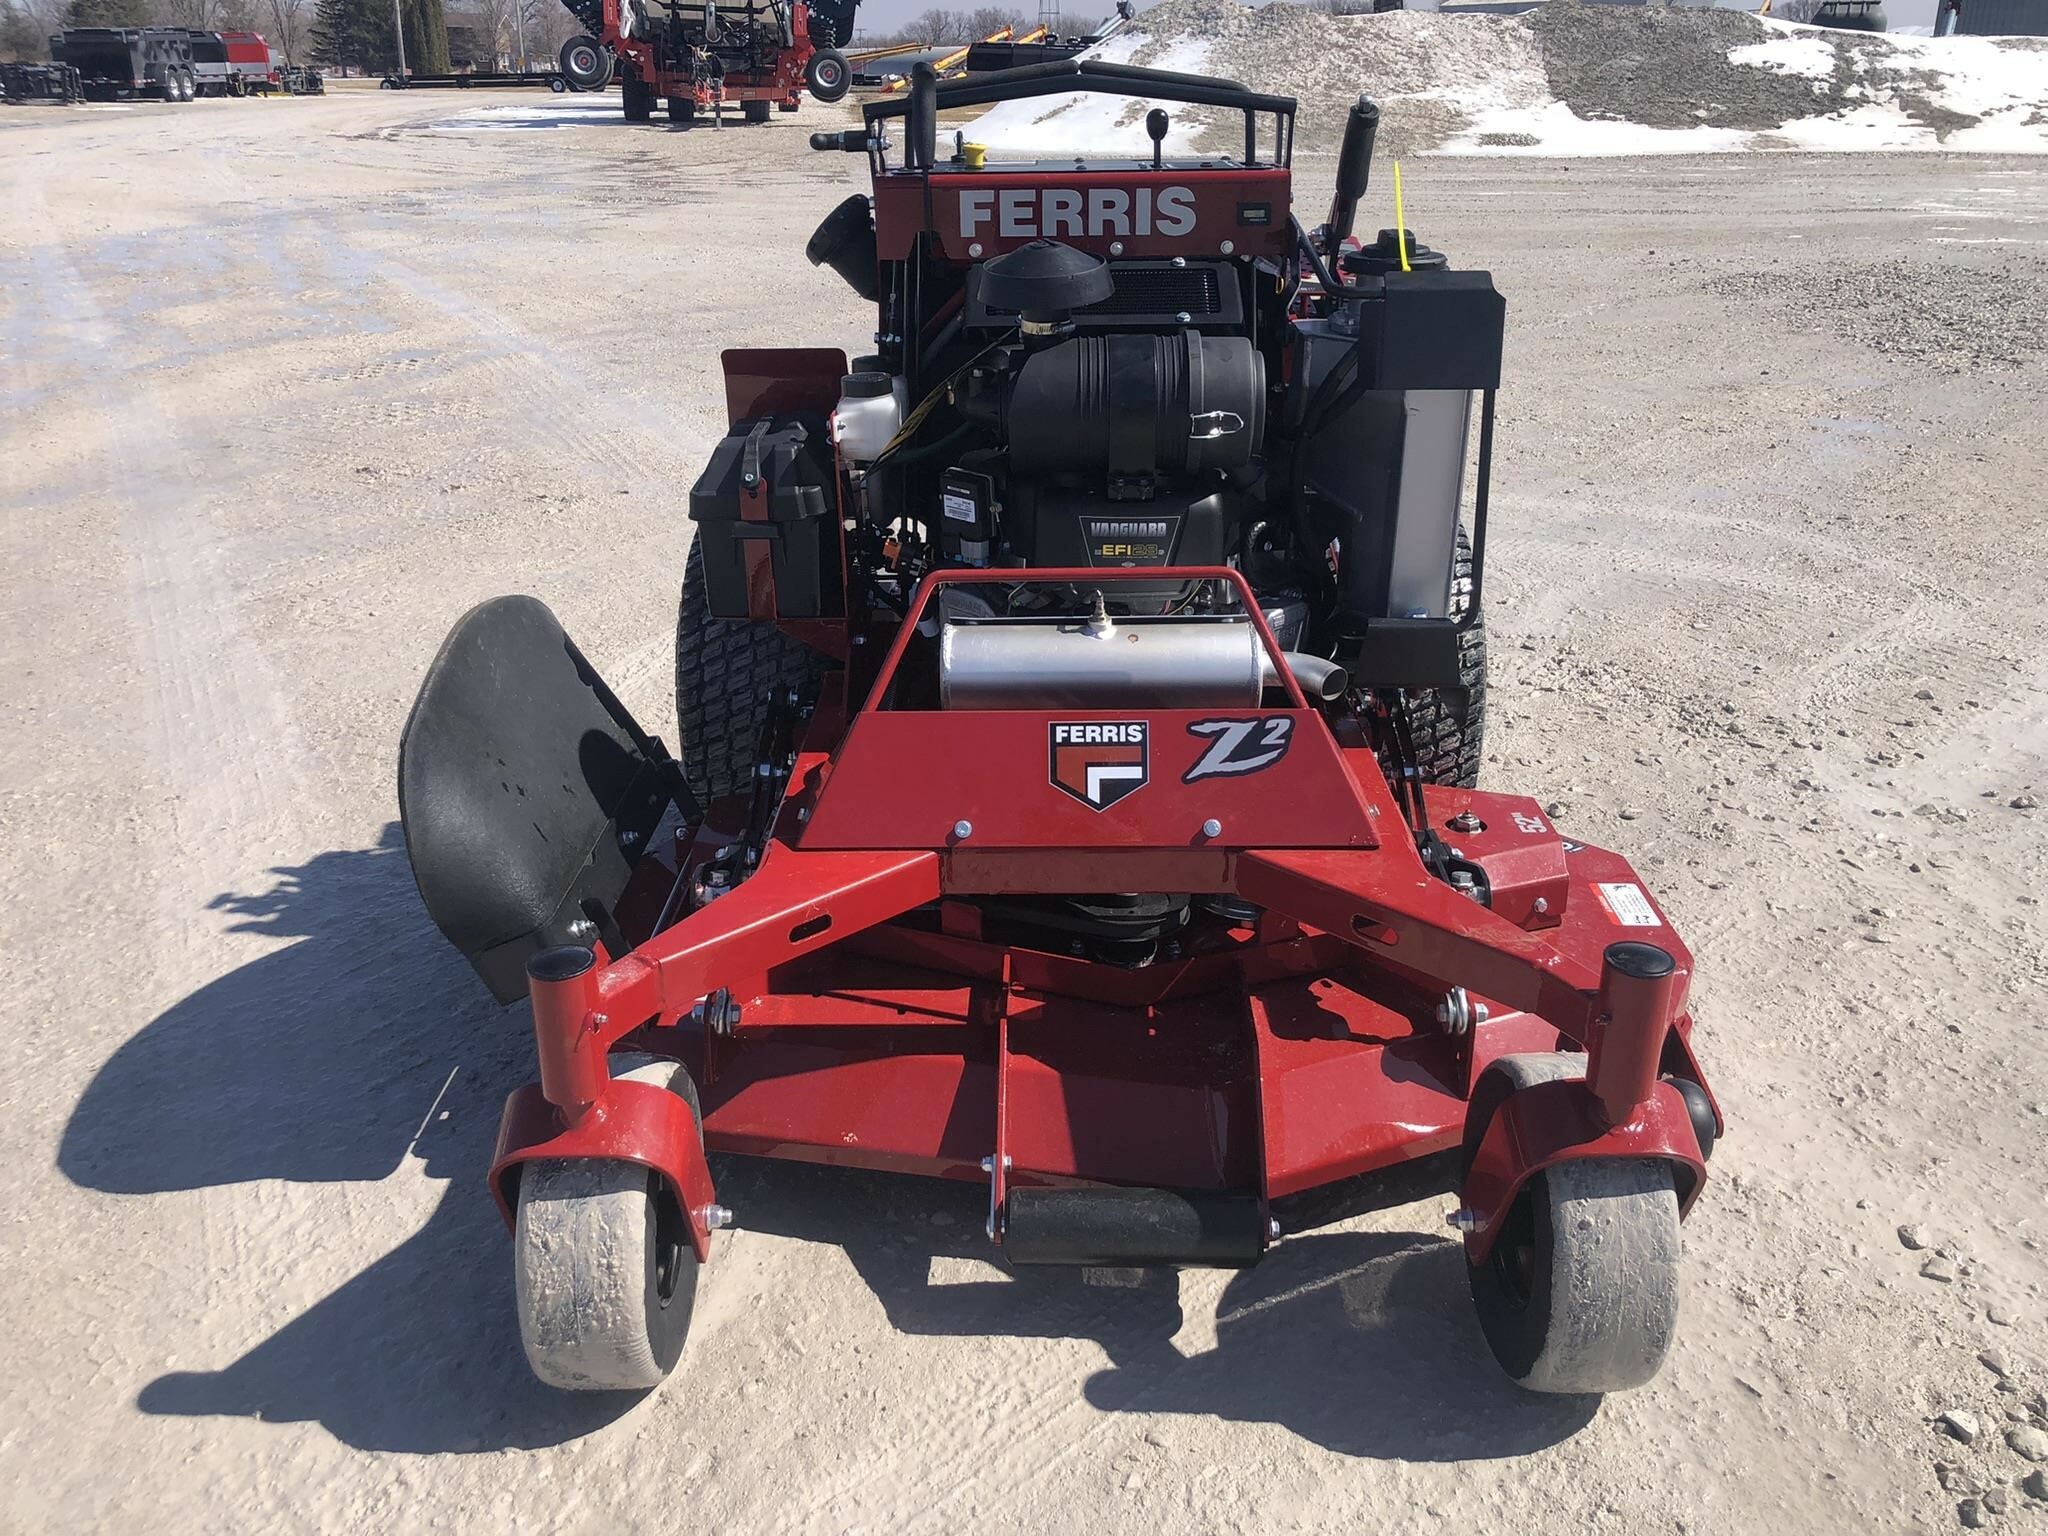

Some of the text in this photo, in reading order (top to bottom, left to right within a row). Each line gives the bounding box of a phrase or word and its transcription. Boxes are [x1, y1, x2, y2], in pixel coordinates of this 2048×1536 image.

[960, 187, 1197, 237] FERRIS
[1091, 522, 1167, 537] VANGUARD
[1055, 725, 1143, 743] FERRIS
